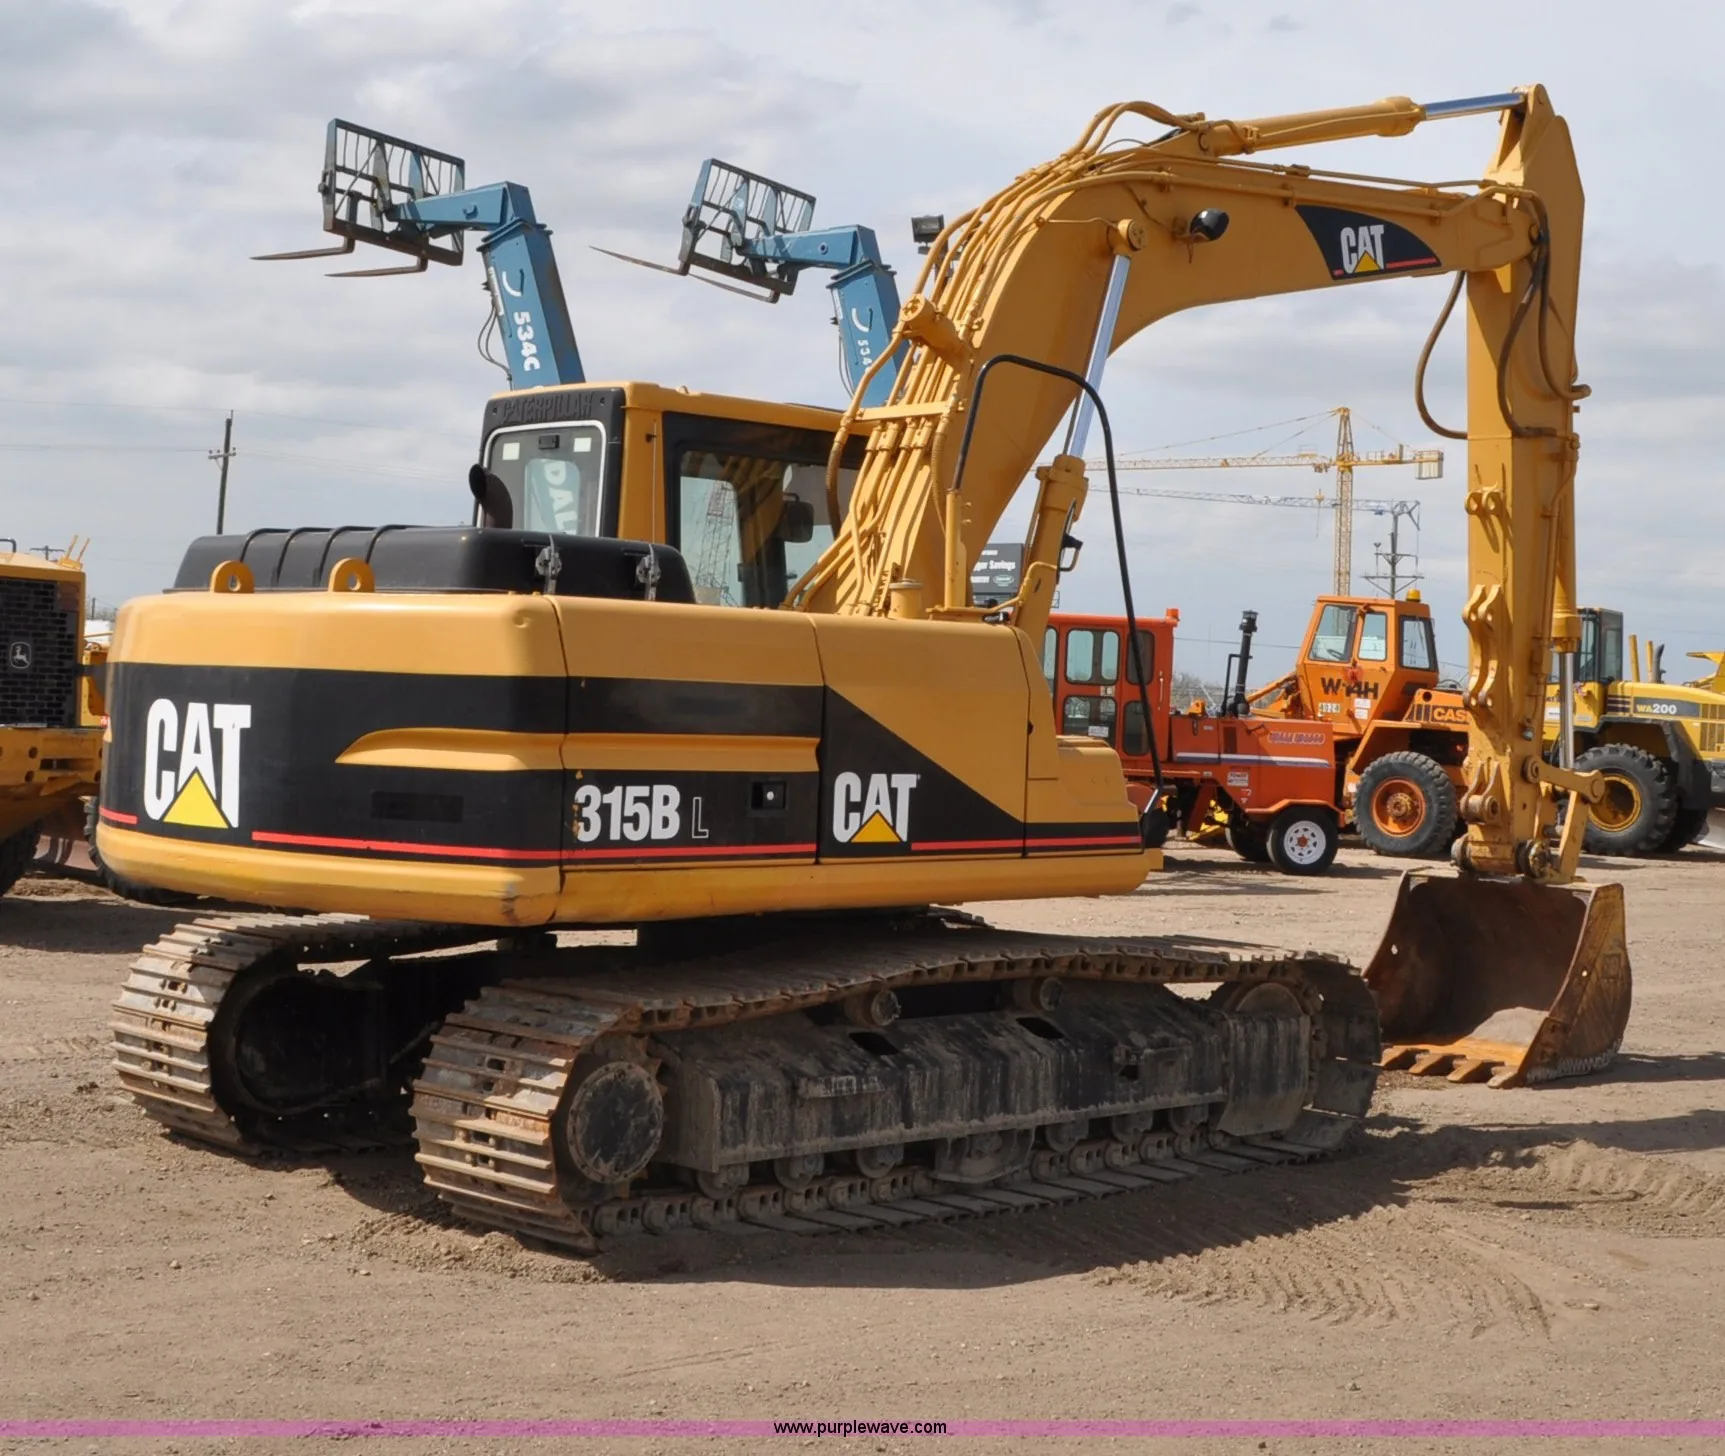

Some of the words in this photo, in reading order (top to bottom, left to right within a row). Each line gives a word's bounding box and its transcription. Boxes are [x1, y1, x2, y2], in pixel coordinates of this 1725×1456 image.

[1340, 225, 1385, 274] CAT
[513, 311, 541, 371] 534C
[502, 391, 594, 422] CATERPILLAR
[989, 560, 1016, 571] Savings
[1433, 707, 1472, 722] CAS
[1636, 703, 1678, 715] WA200
[144, 698, 251, 828] CAT
[574, 784, 681, 842] 315B
[691, 796, 709, 839] L
[832, 771, 918, 843] CAT
